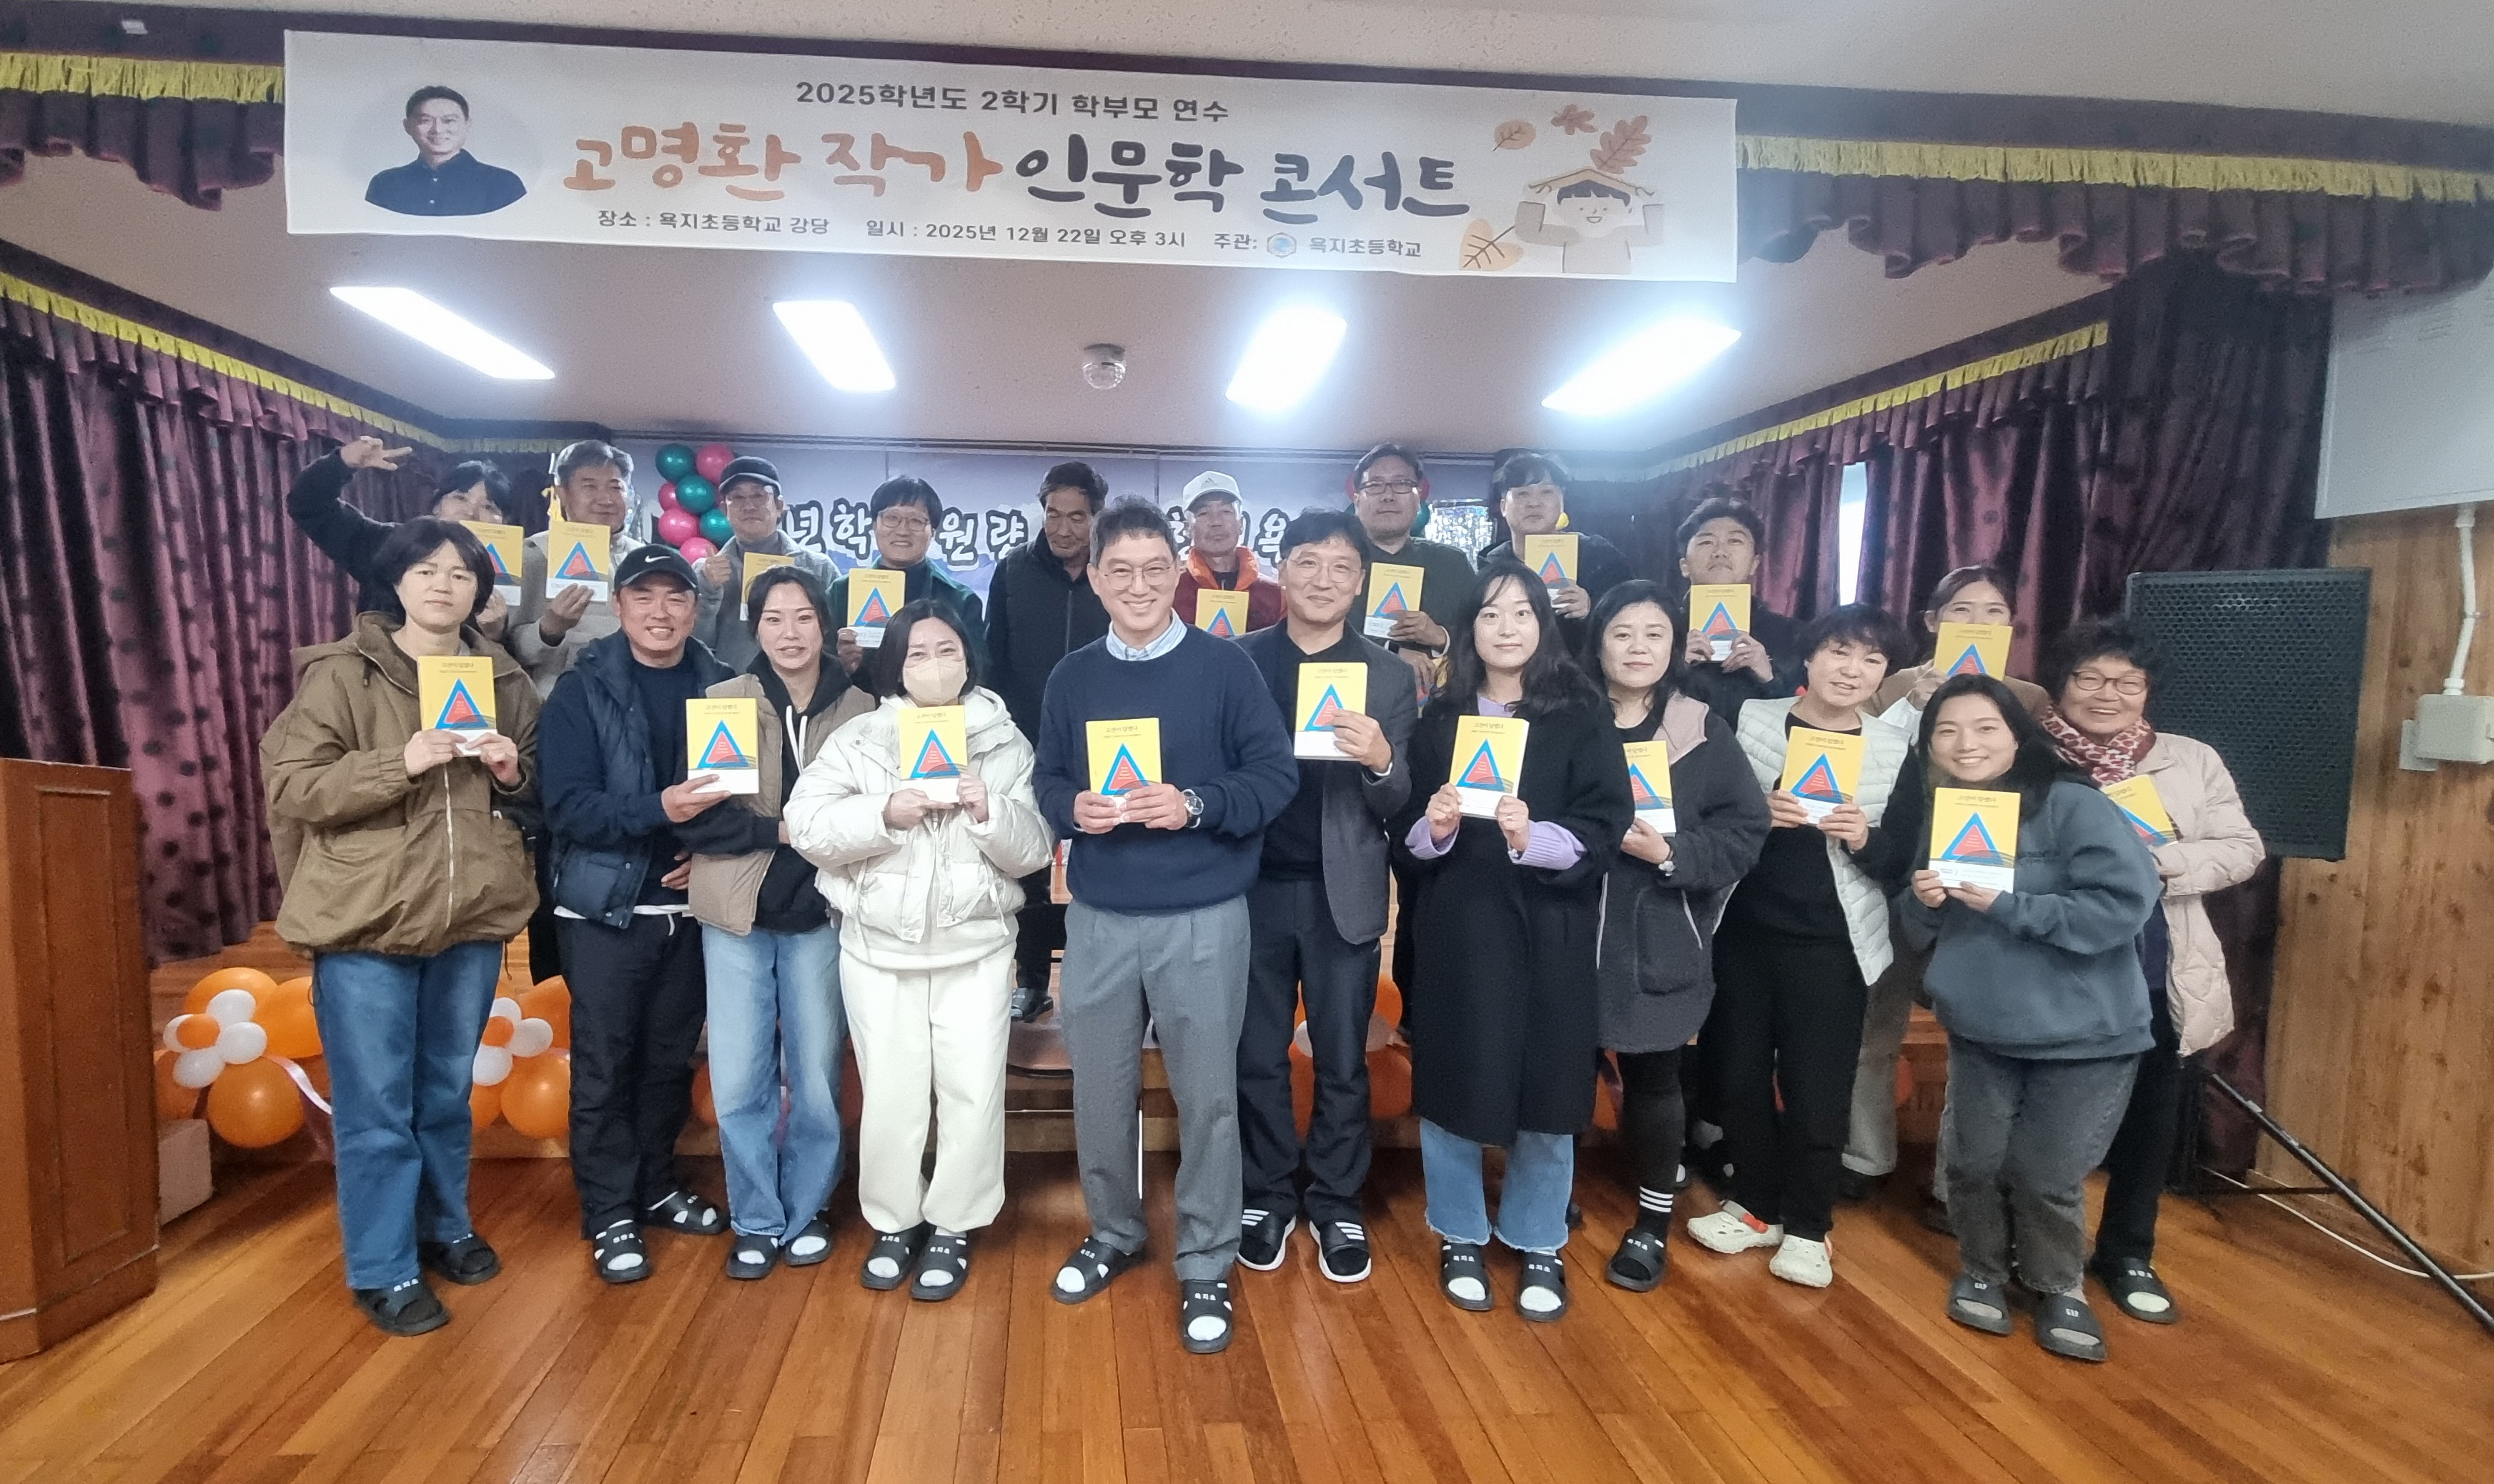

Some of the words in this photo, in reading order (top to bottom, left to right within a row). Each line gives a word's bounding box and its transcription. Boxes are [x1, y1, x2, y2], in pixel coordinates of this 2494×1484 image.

[796, 81, 968, 110] 2025학년도
[981, 89, 1058, 116] 2학기
[1071, 94, 1159, 120] 학부모
[1173, 99, 1229, 123] 연수
[563, 121, 802, 202] 고명환
[821, 131, 1004, 197] 작가
[1015, 133, 1244, 219] 인문학
[1260, 151, 1470, 225] 콘서트
[598, 209, 637, 227] 장소
[659, 212, 781, 232] 욕지초등학교
[790, 217, 829, 234] 강당
[866, 219, 904, 237] 일시
[926, 223, 996, 242] 2025년
[1006, 227, 1048, 243] 12월
[1057, 228, 1101, 244] 22일
[1109, 229, 1147, 246] 오후
[1154, 232, 1185, 248] 3시
[1214, 233, 1259, 250] 주관:
[1308, 236, 1422, 257] 욕지초등학교
